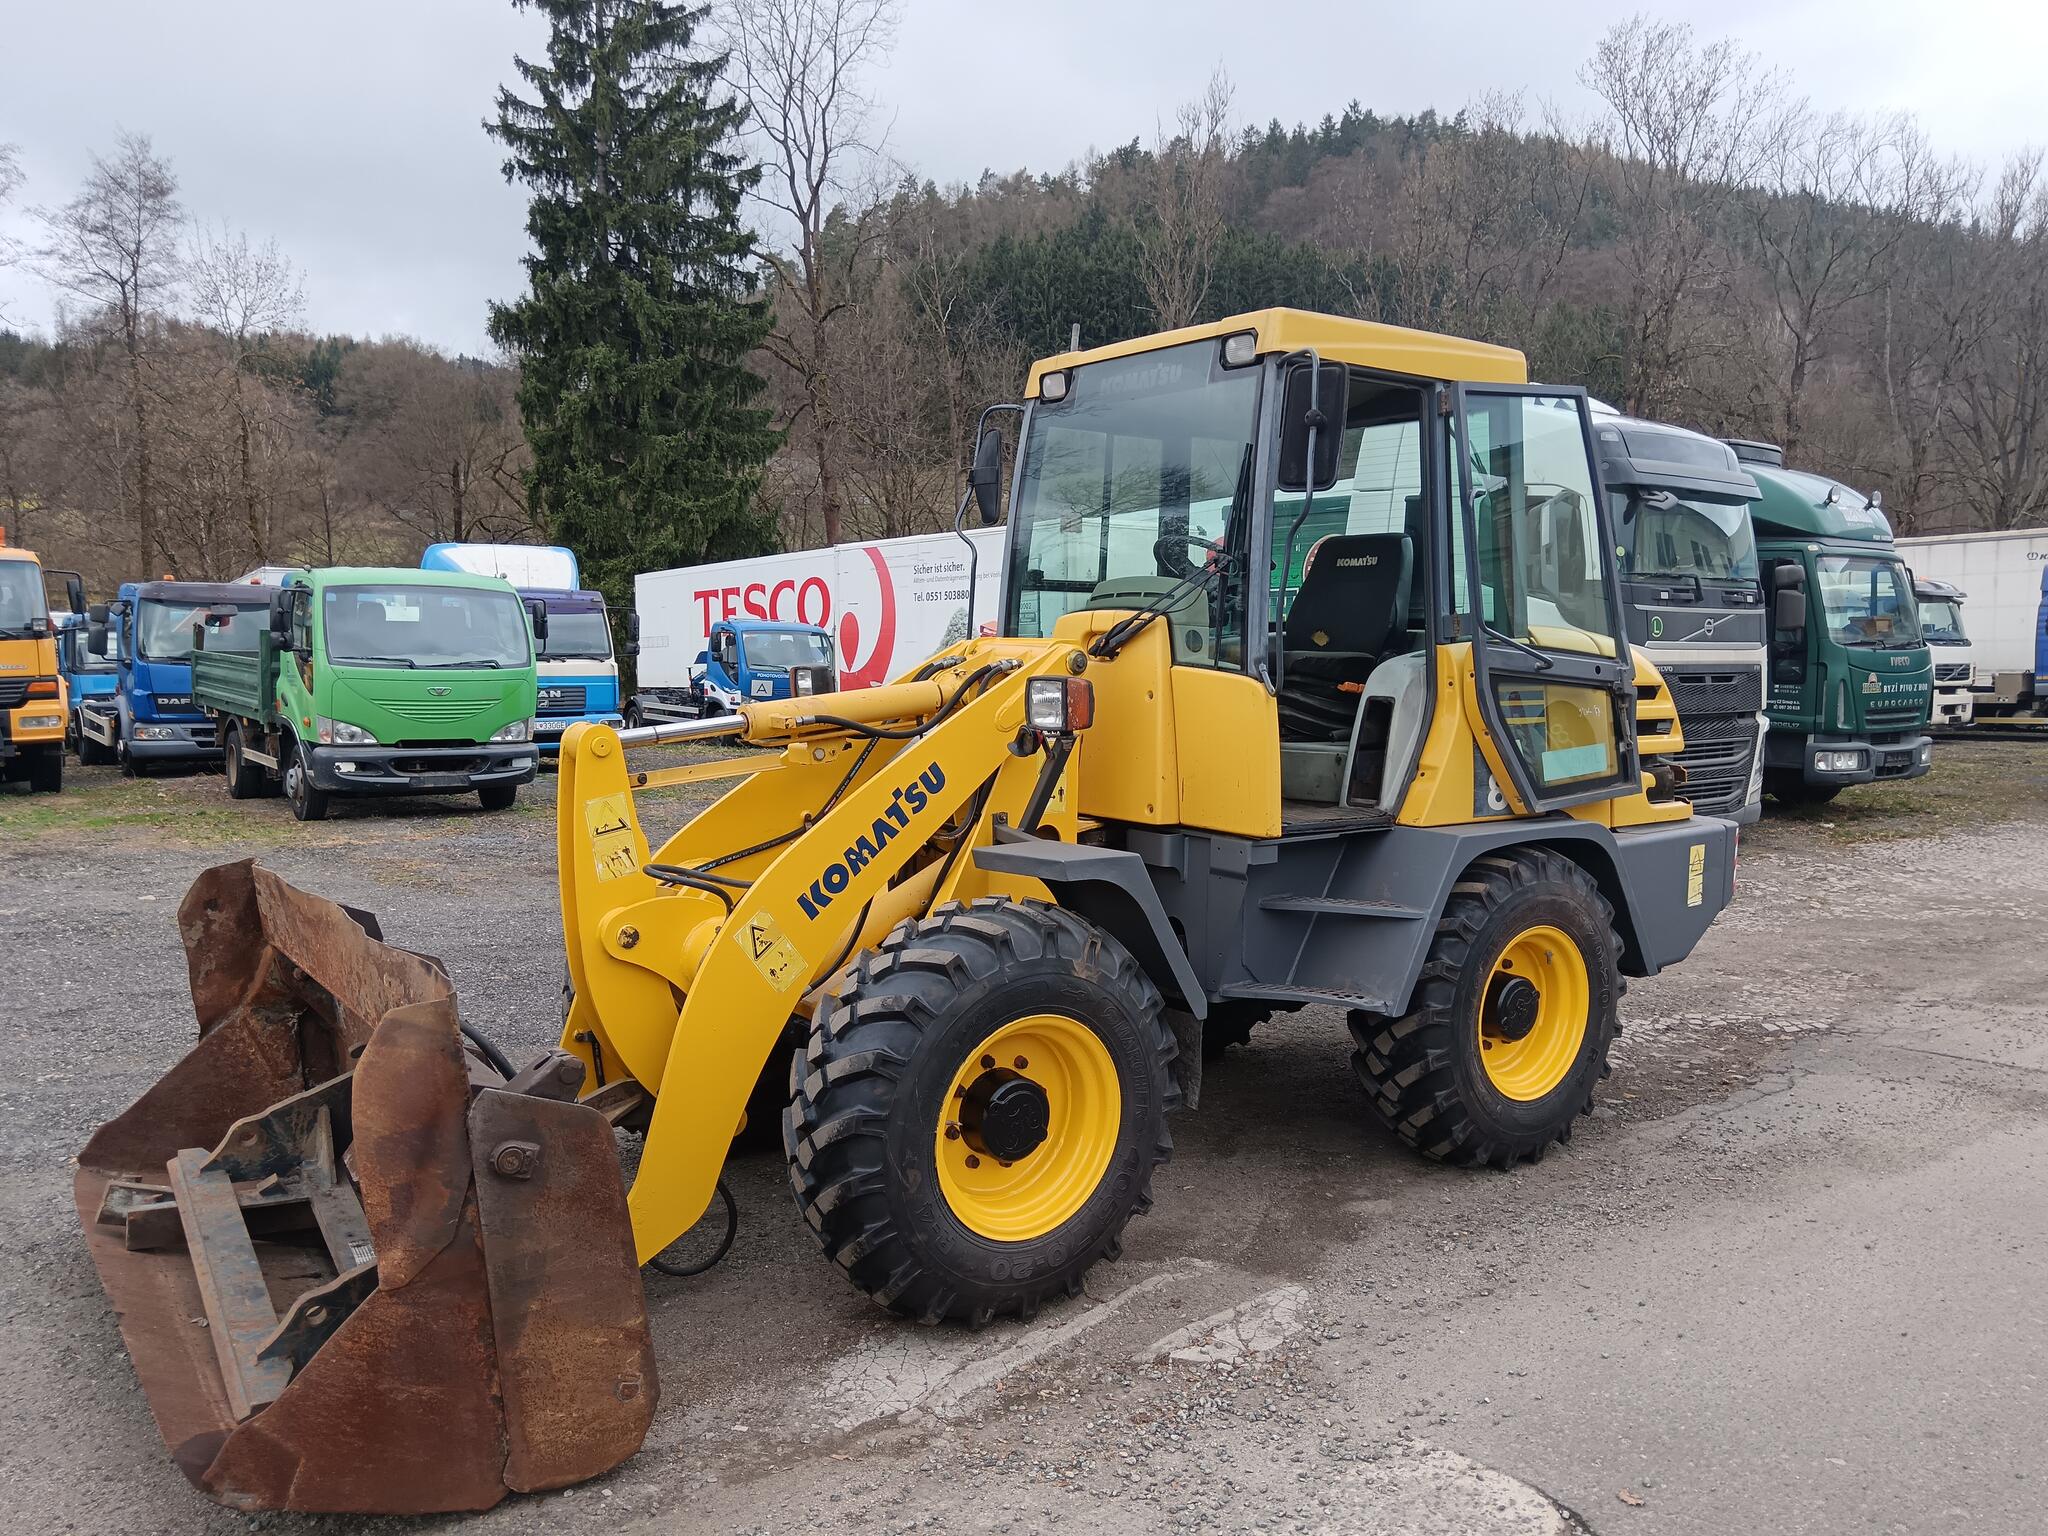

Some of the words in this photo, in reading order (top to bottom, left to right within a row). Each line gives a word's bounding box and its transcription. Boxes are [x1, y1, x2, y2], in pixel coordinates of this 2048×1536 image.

[1336, 555, 1378, 567] KOMATSU
[913, 563, 933, 575] Sicher
[934, 562, 943, 574] ist
[944, 561, 966, 573] sicher.
[913, 592, 925, 602] Tel.
[926, 591, 942, 602] 0551
[944, 590, 970, 601] 503880
[693, 576, 831, 638] TESCO
[1890, 656, 1911, 667] IVECO
[1657, 665, 1674, 673] OLVO
[756, 683, 768, 695] A
[1883, 682, 1898, 693] RYZÍ
[1899, 683, 1912, 692] PIVO
[537, 689, 561, 698] AN
[157, 697, 191, 705] DAF
[1870, 698, 1924, 708] EUROCARGO
[796, 761, 946, 922] KOMATSU
